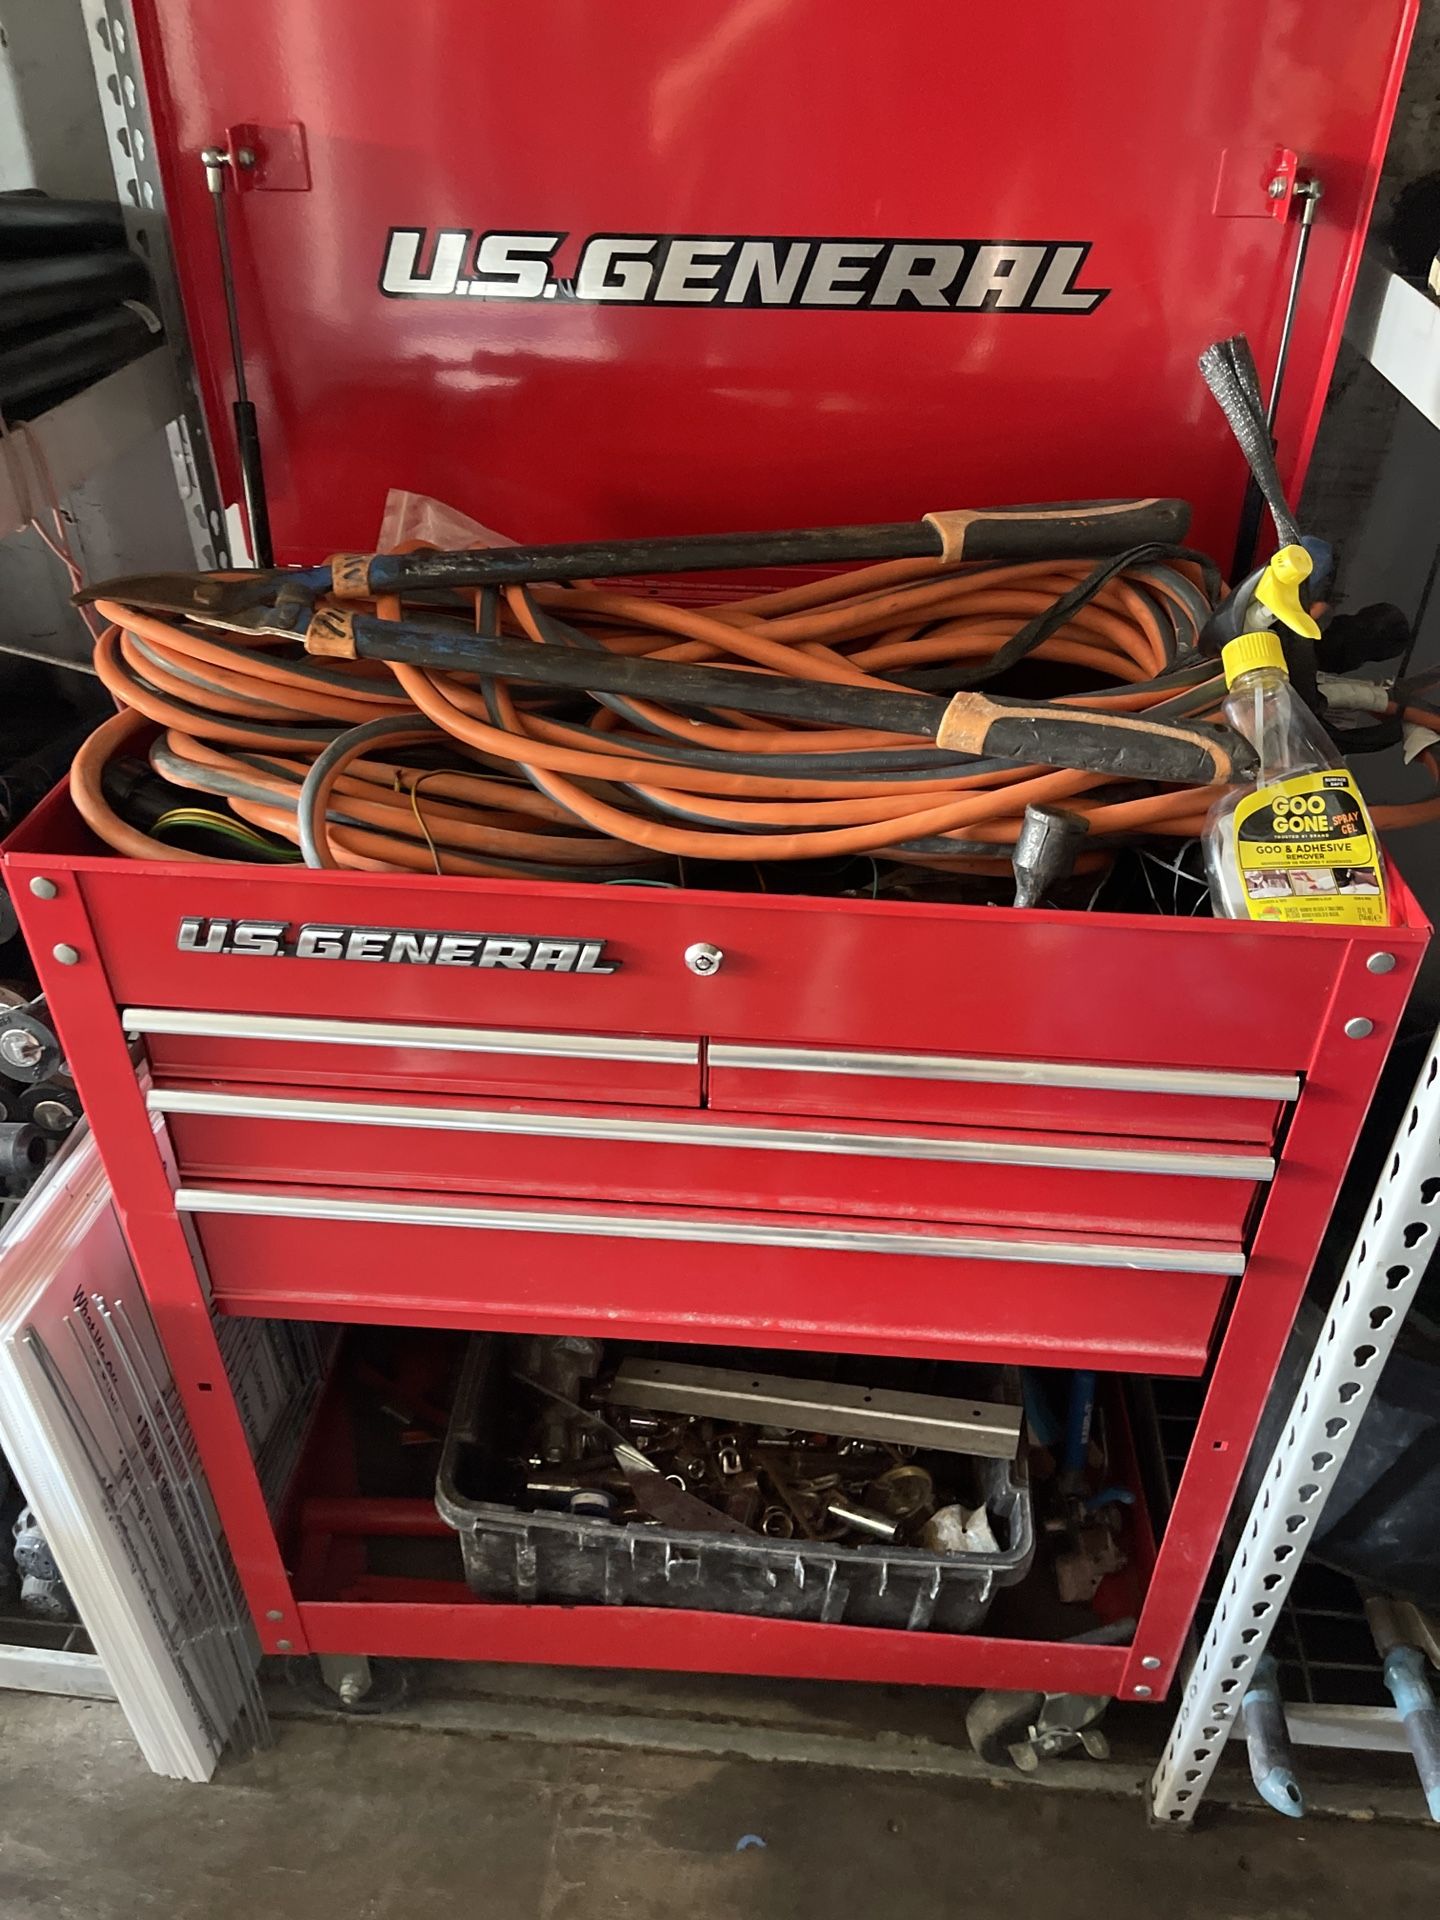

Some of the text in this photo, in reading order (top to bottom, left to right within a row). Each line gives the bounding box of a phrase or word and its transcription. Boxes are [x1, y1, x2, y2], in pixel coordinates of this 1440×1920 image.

[1272, 795, 1326, 815] GOO
[1332, 811, 1359, 826] SPRAY
[1341, 823, 1358, 834] GEL
[1256, 842, 1352, 855] GOO & ADHESIVE
